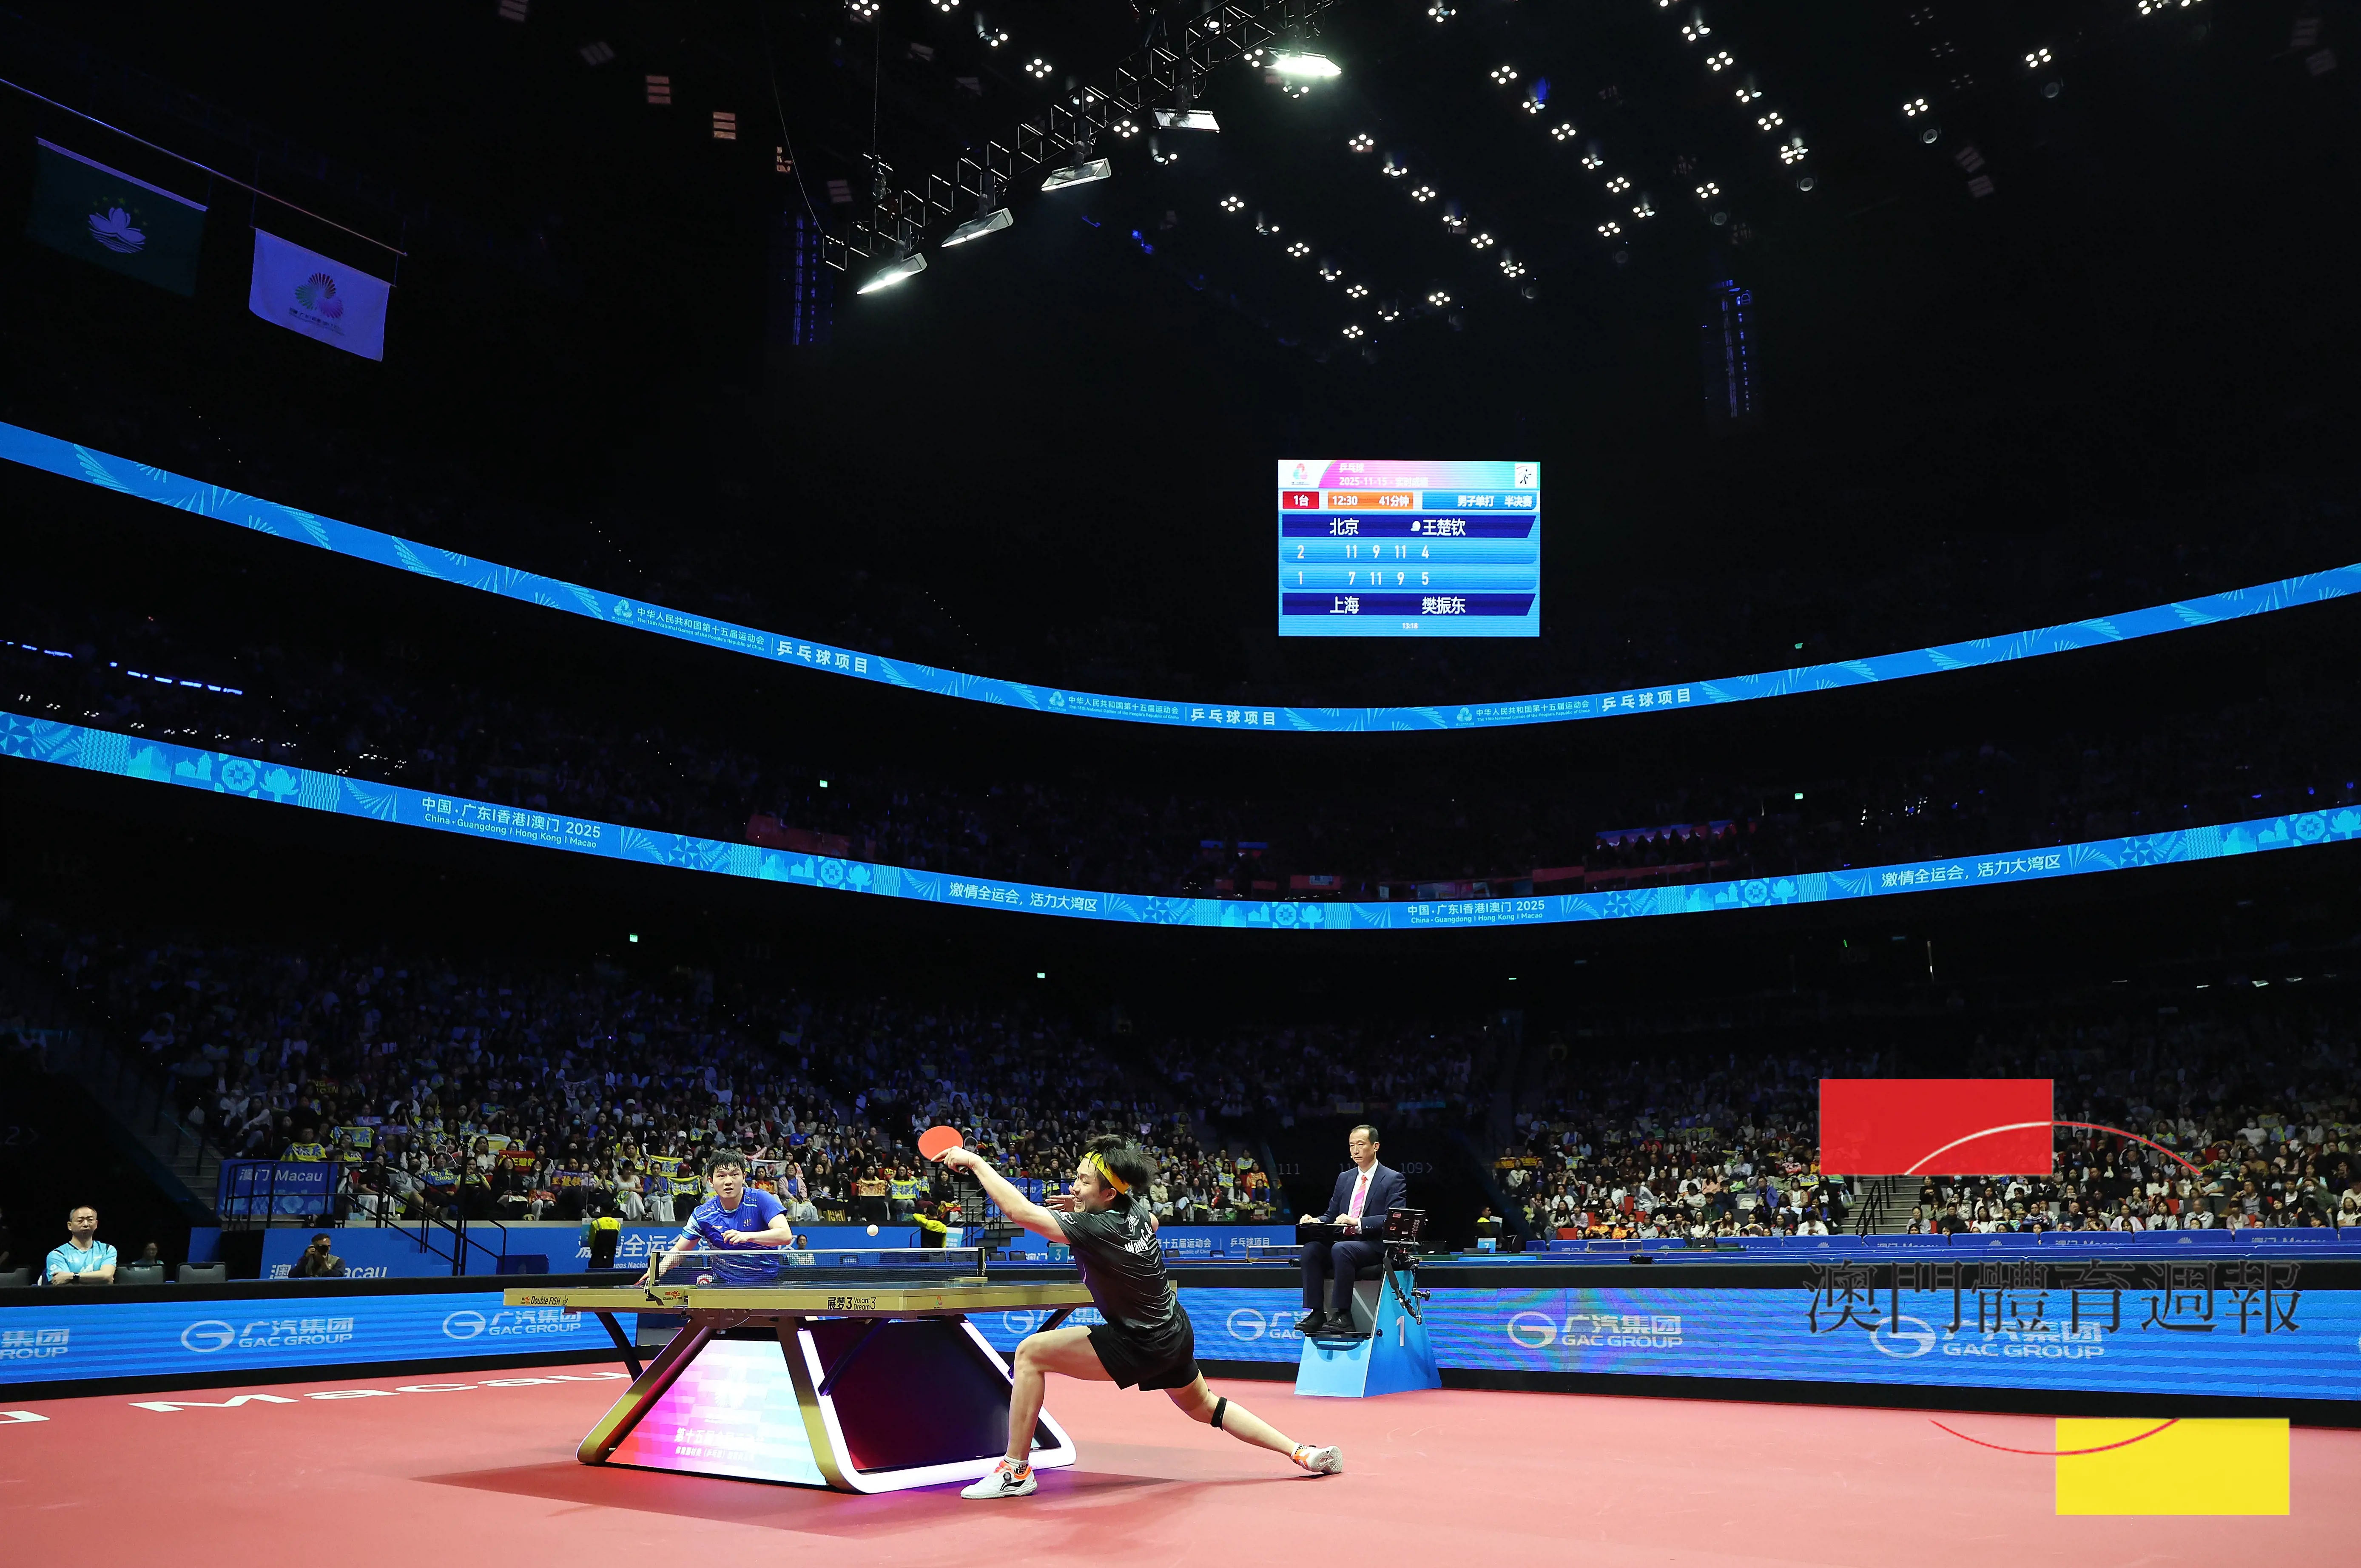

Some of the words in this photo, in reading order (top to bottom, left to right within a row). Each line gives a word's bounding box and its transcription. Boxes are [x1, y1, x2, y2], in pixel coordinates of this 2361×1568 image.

[1294, 494, 1309, 506] 1台
[1332, 496, 1358, 506] 12:30
[1379, 496, 1410, 507] 41分钟
[1457, 495, 1494, 507] 男子单打
[1504, 495, 1533, 508] 半决赛
[1329, 518, 1359, 536] 北京
[1422, 519, 1466, 536] 王楚钦
[1297, 545, 1304, 559] 2
[1345, 545, 1357, 558] 11
[1373, 545, 1380, 558] 9
[1395, 545, 1406, 558] 11
[1422, 545, 1429, 559] 4
[1298, 571, 1303, 585] 1
[1348, 571, 1356, 585] 7
[1370, 571, 1382, 585] 11
[1397, 571, 1404, 585] 9
[1422, 571, 1429, 585] 5
[1329, 597, 1359, 614] 上海
[1422, 597, 1466, 614] 樊振东
[658, 622, 677, 631] National
[678, 627, 693, 635] Games
[637, 608, 765, 645] 中华人民共和国第十五届运动会
[777, 641, 868, 673] 乒乓球项目
[1476, 700, 1589, 716] 中华人民共和国第十五届运动会
[1602, 687, 1690, 712] 乒乓球项目
[1069, 696, 1179, 714] 中华人民共和国第十五届运动会
[1191, 708, 1275, 725] 乒乓球项目
[425, 814, 450, 825] China
[457, 819, 506, 835] Guangdong
[515, 828, 537, 841] Hong
[540, 832, 561, 844] Kong
[570, 837, 596, 848] Macao
[566, 821, 600, 838] 2025
[1516, 900, 1545, 912] 2025
[1434, 915, 1472, 923] Guangdong
[275, 1170, 323, 1182] Macau
[1278, 1163, 1300, 1175] 111
[1124, 1236, 1148, 1254] Wang
[1055, 1249, 1061, 1261] 3
[530, 1295, 548, 1304] Double
[549, 1296, 561, 1305] FISH
[828, 1297, 853, 1310] 展梦3
[239, 1318, 354, 1337] 广汽集团
[489, 1324, 523, 1336] GAC
[526, 1322, 581, 1335] GROUP
[1397, 1316, 1405, 1346] 1
[1562, 1315, 1682, 1335] 广汽集团
[239, 1336, 282, 1348] GAC
[284, 1333, 353, 1347] GROUP
[1269, 1329, 1303, 1339] GAC
[1562, 1335, 1604, 1346] GAC
[1607, 1336, 1683, 1348] GROUP
[1943, 1343, 1999, 1356] GAC
[2003, 1344, 2105, 1359] GROUP
[128, 1372, 632, 1412] Macau
